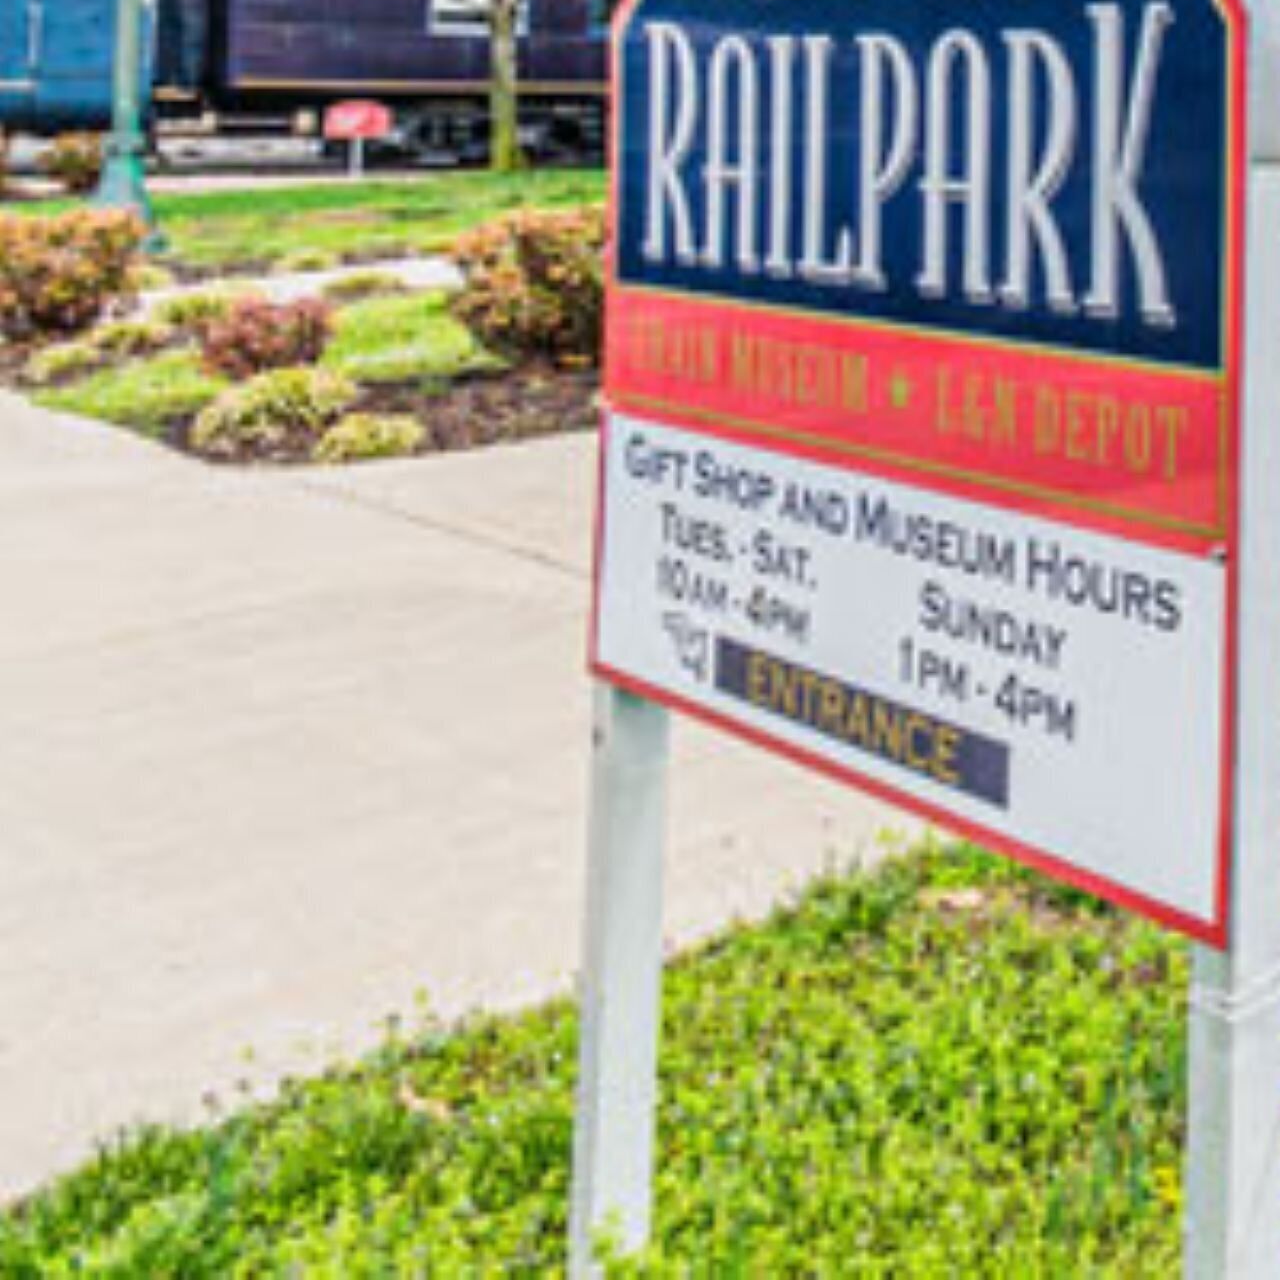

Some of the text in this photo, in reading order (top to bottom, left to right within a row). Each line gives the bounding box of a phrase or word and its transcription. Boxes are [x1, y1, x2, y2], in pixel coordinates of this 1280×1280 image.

[642, 1, 1174, 326] RAILPARK
[1035, 384, 1187, 479] DEPOT
[624, 433, 1182, 631] GIFT SHOP AND MUSEUM HOURS
[659, 502, 734, 563] TUES.
[752, 527, 819, 591] SAT.
[745, 585, 814, 646] 4PM
[918, 580, 1068, 669] SUNDAY
[746, 651, 962, 783] ENTRANCE
[898, 634, 970, 704] 1PM
[994, 672, 1077, 744] 4PM
